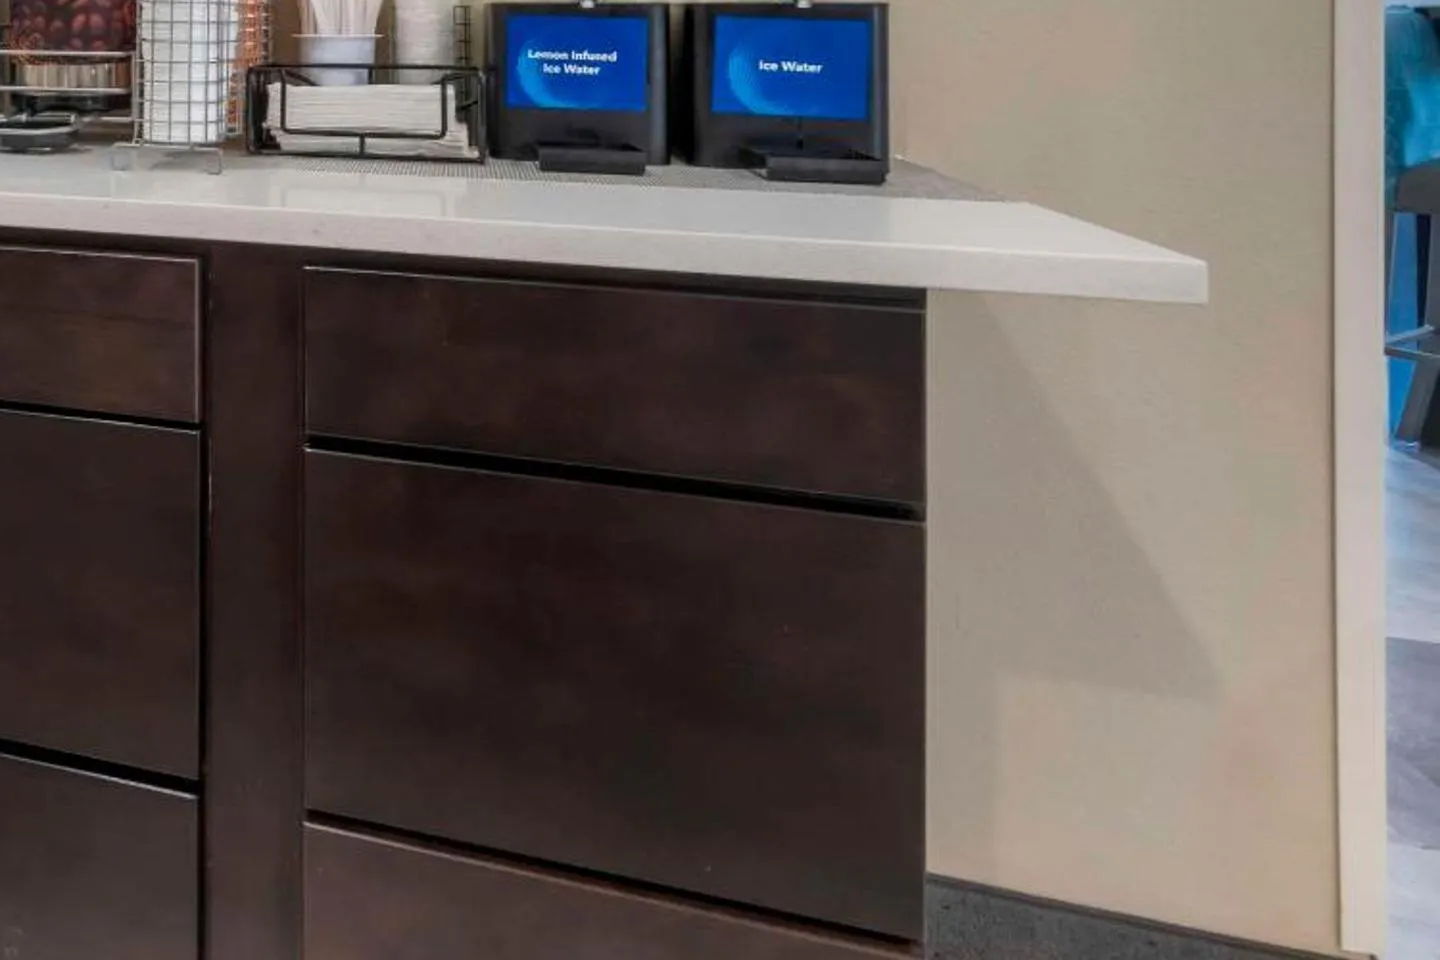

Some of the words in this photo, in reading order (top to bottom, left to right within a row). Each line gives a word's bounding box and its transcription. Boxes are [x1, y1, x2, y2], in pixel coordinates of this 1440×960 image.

[571, 50, 618, 62] Infused
[542, 63, 561, 74] Ice
[563, 63, 601, 76] Water
[759, 59, 779, 71] Ice
[780, 60, 823, 74] Water
